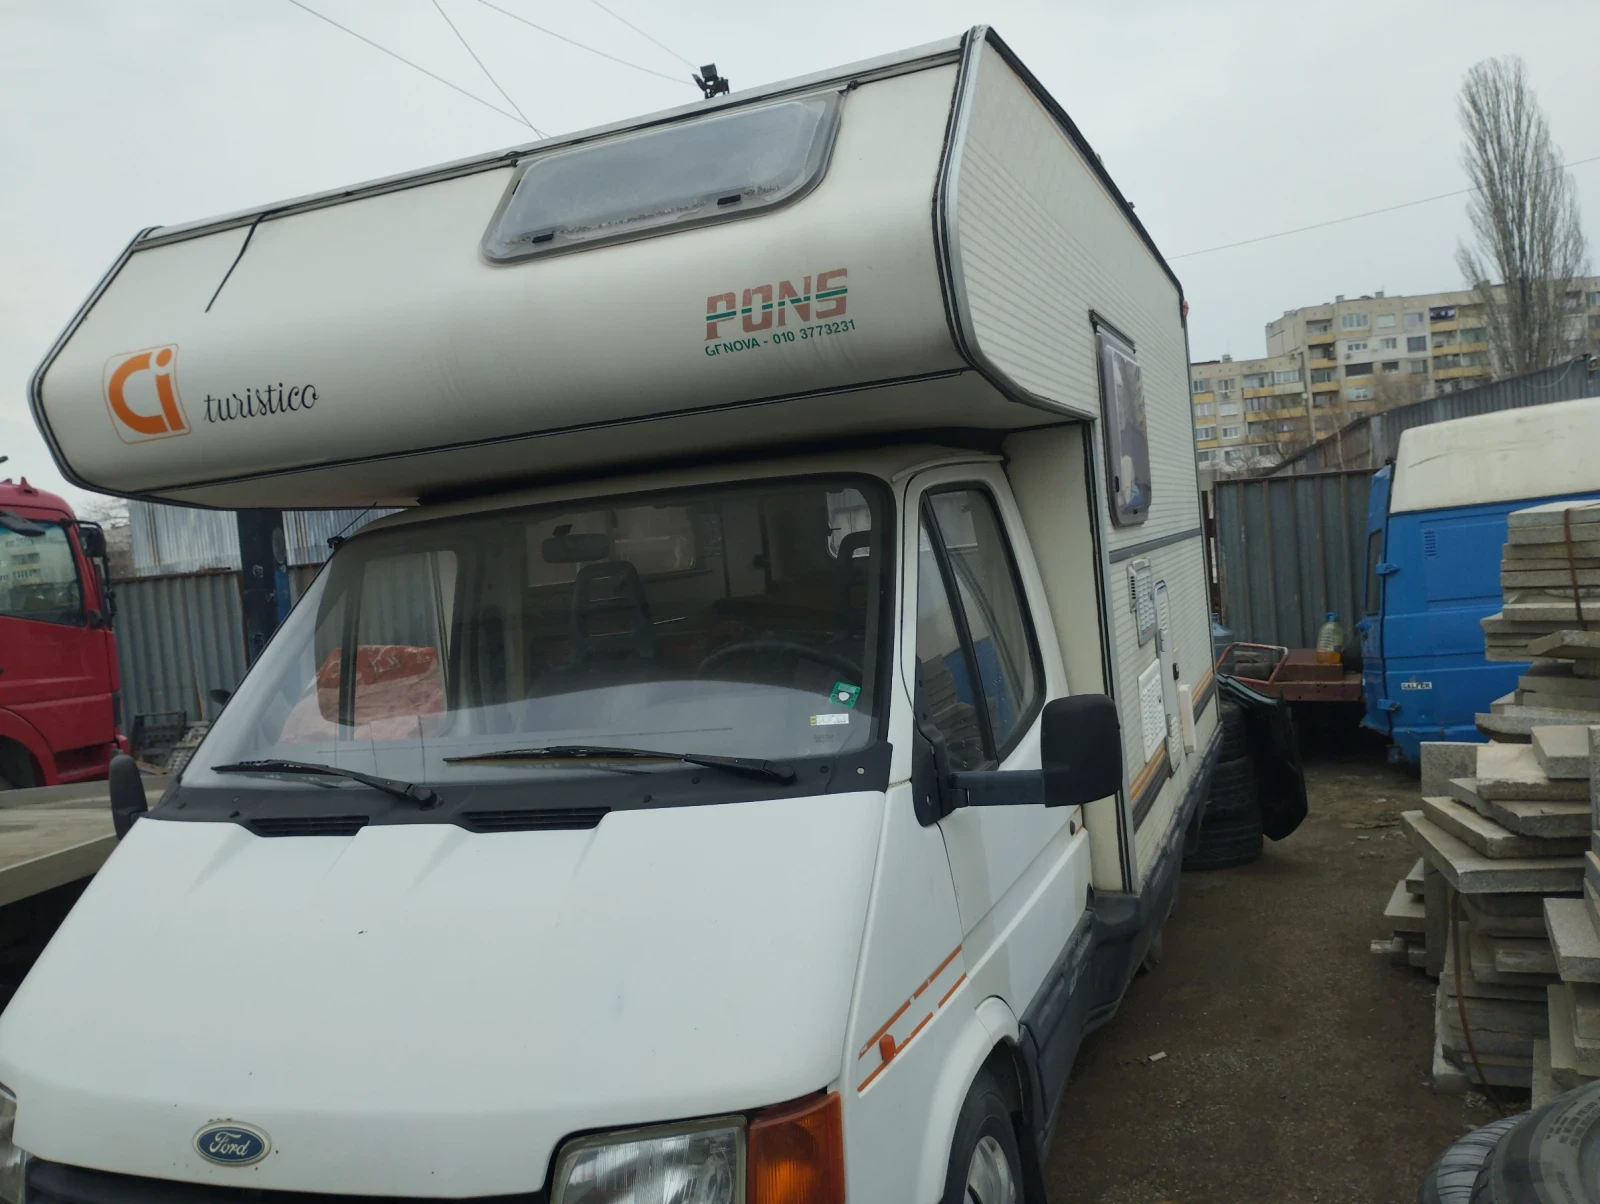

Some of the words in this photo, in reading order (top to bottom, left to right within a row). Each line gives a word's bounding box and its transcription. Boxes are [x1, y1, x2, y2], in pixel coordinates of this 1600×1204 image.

[704, 268, 848, 341] PONS
[772, 331, 795, 344] 010
[799, 319, 856, 340] 3773231
[108, 348, 186, 435] Ci
[203, 382, 319, 423] turistico
[209, 1131, 251, 1156] Ford
